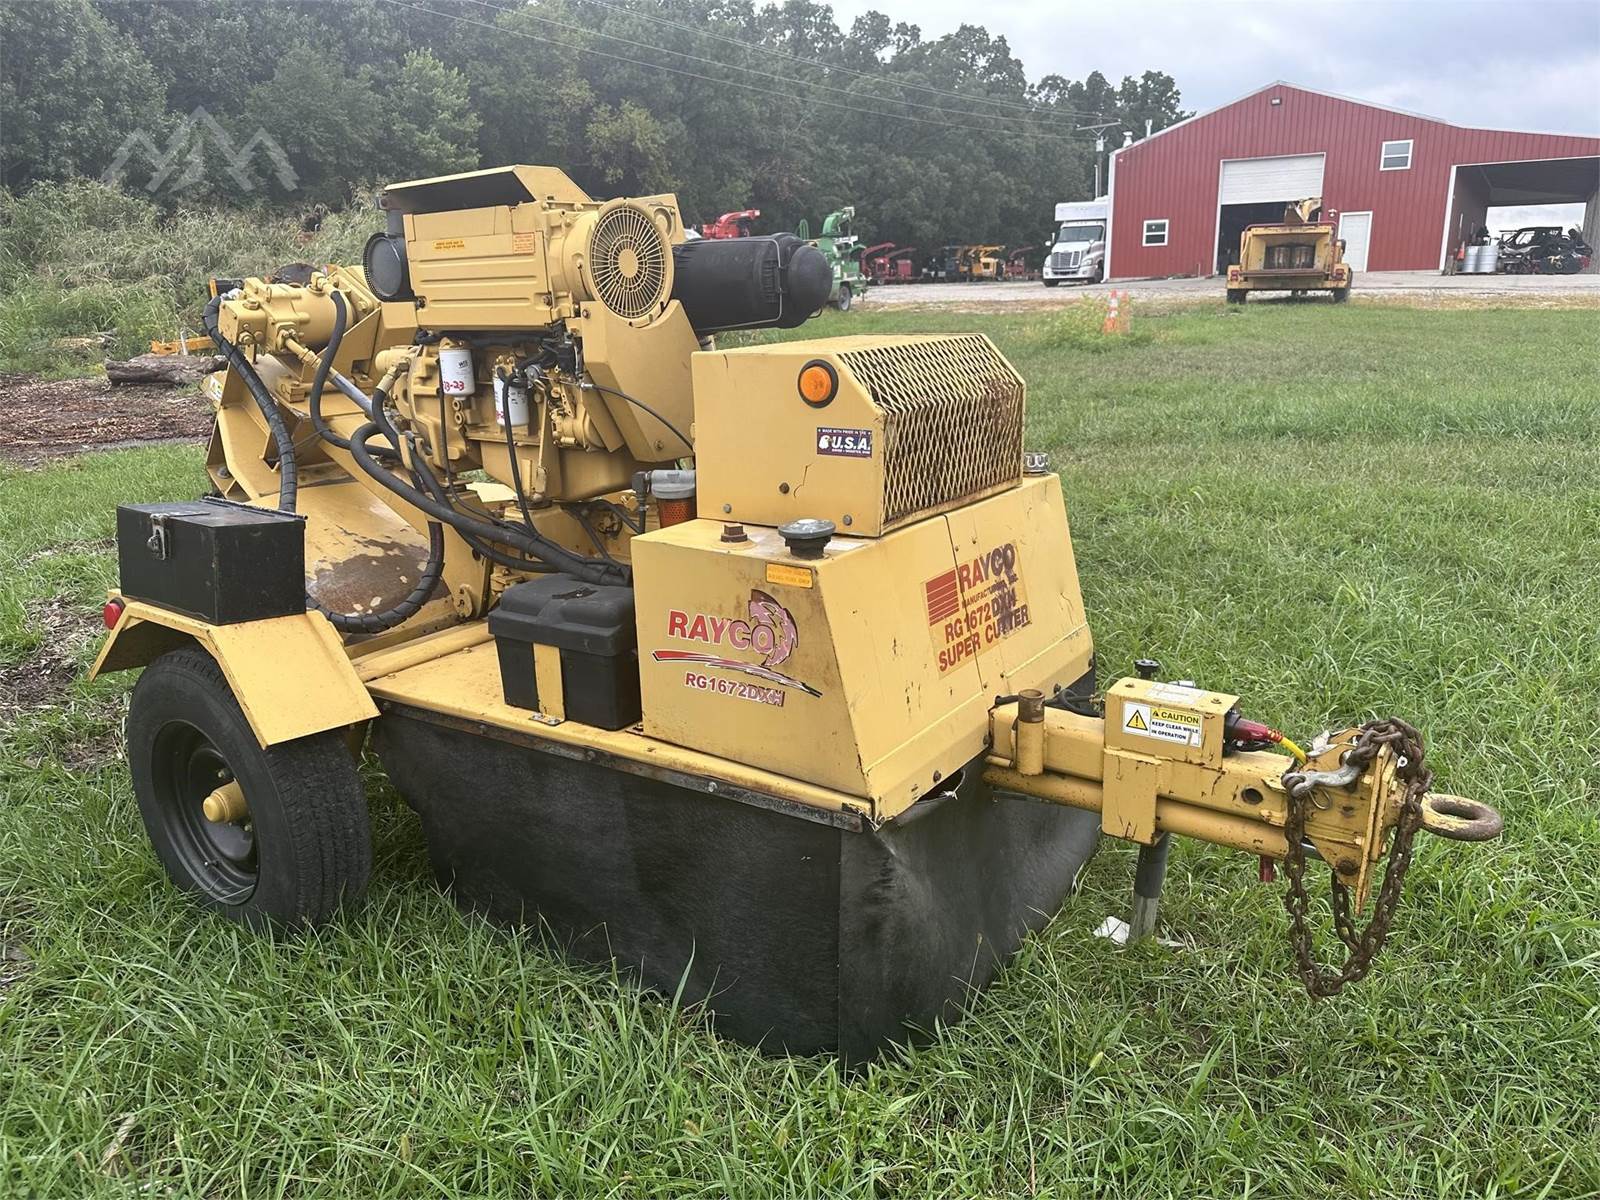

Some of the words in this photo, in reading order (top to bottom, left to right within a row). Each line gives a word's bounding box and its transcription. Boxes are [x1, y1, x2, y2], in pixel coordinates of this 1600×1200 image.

[832, 436, 871, 450] U.S.A.
[959, 543, 1015, 593] RAYCO
[668, 609, 776, 655] RAYCO
[939, 631, 981, 672] SUPER
[685, 672, 785, 707] RG1672DXH
[1158, 731, 1186, 739] OPERATION
[1161, 712, 1199, 723] CAUTION
